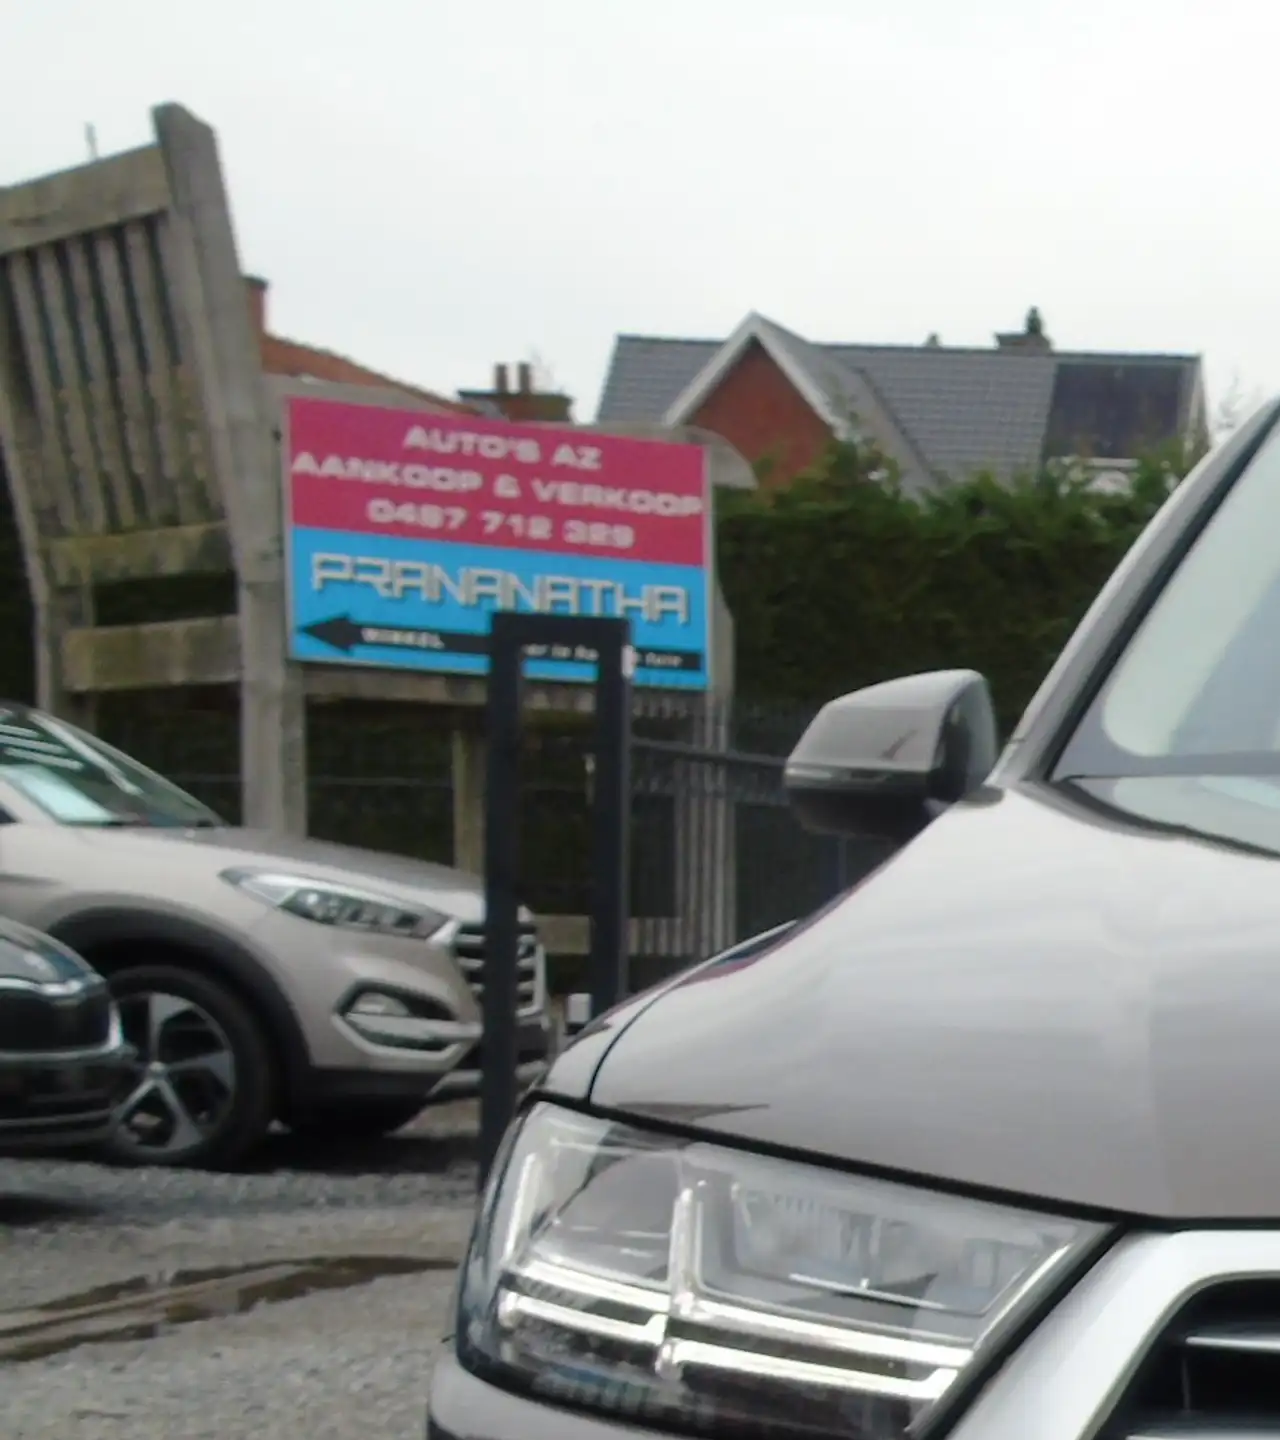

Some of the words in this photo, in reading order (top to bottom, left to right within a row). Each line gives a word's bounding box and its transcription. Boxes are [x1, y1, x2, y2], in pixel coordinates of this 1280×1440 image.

[404, 425, 541, 465] AUTO'S
[551, 443, 602, 470] AZ
[291, 451, 483, 493] AANKOOP
[493, 473, 522, 499] &
[531, 477, 703, 517] VERKOOP
[311, 551, 688, 626] PRANANATHA
